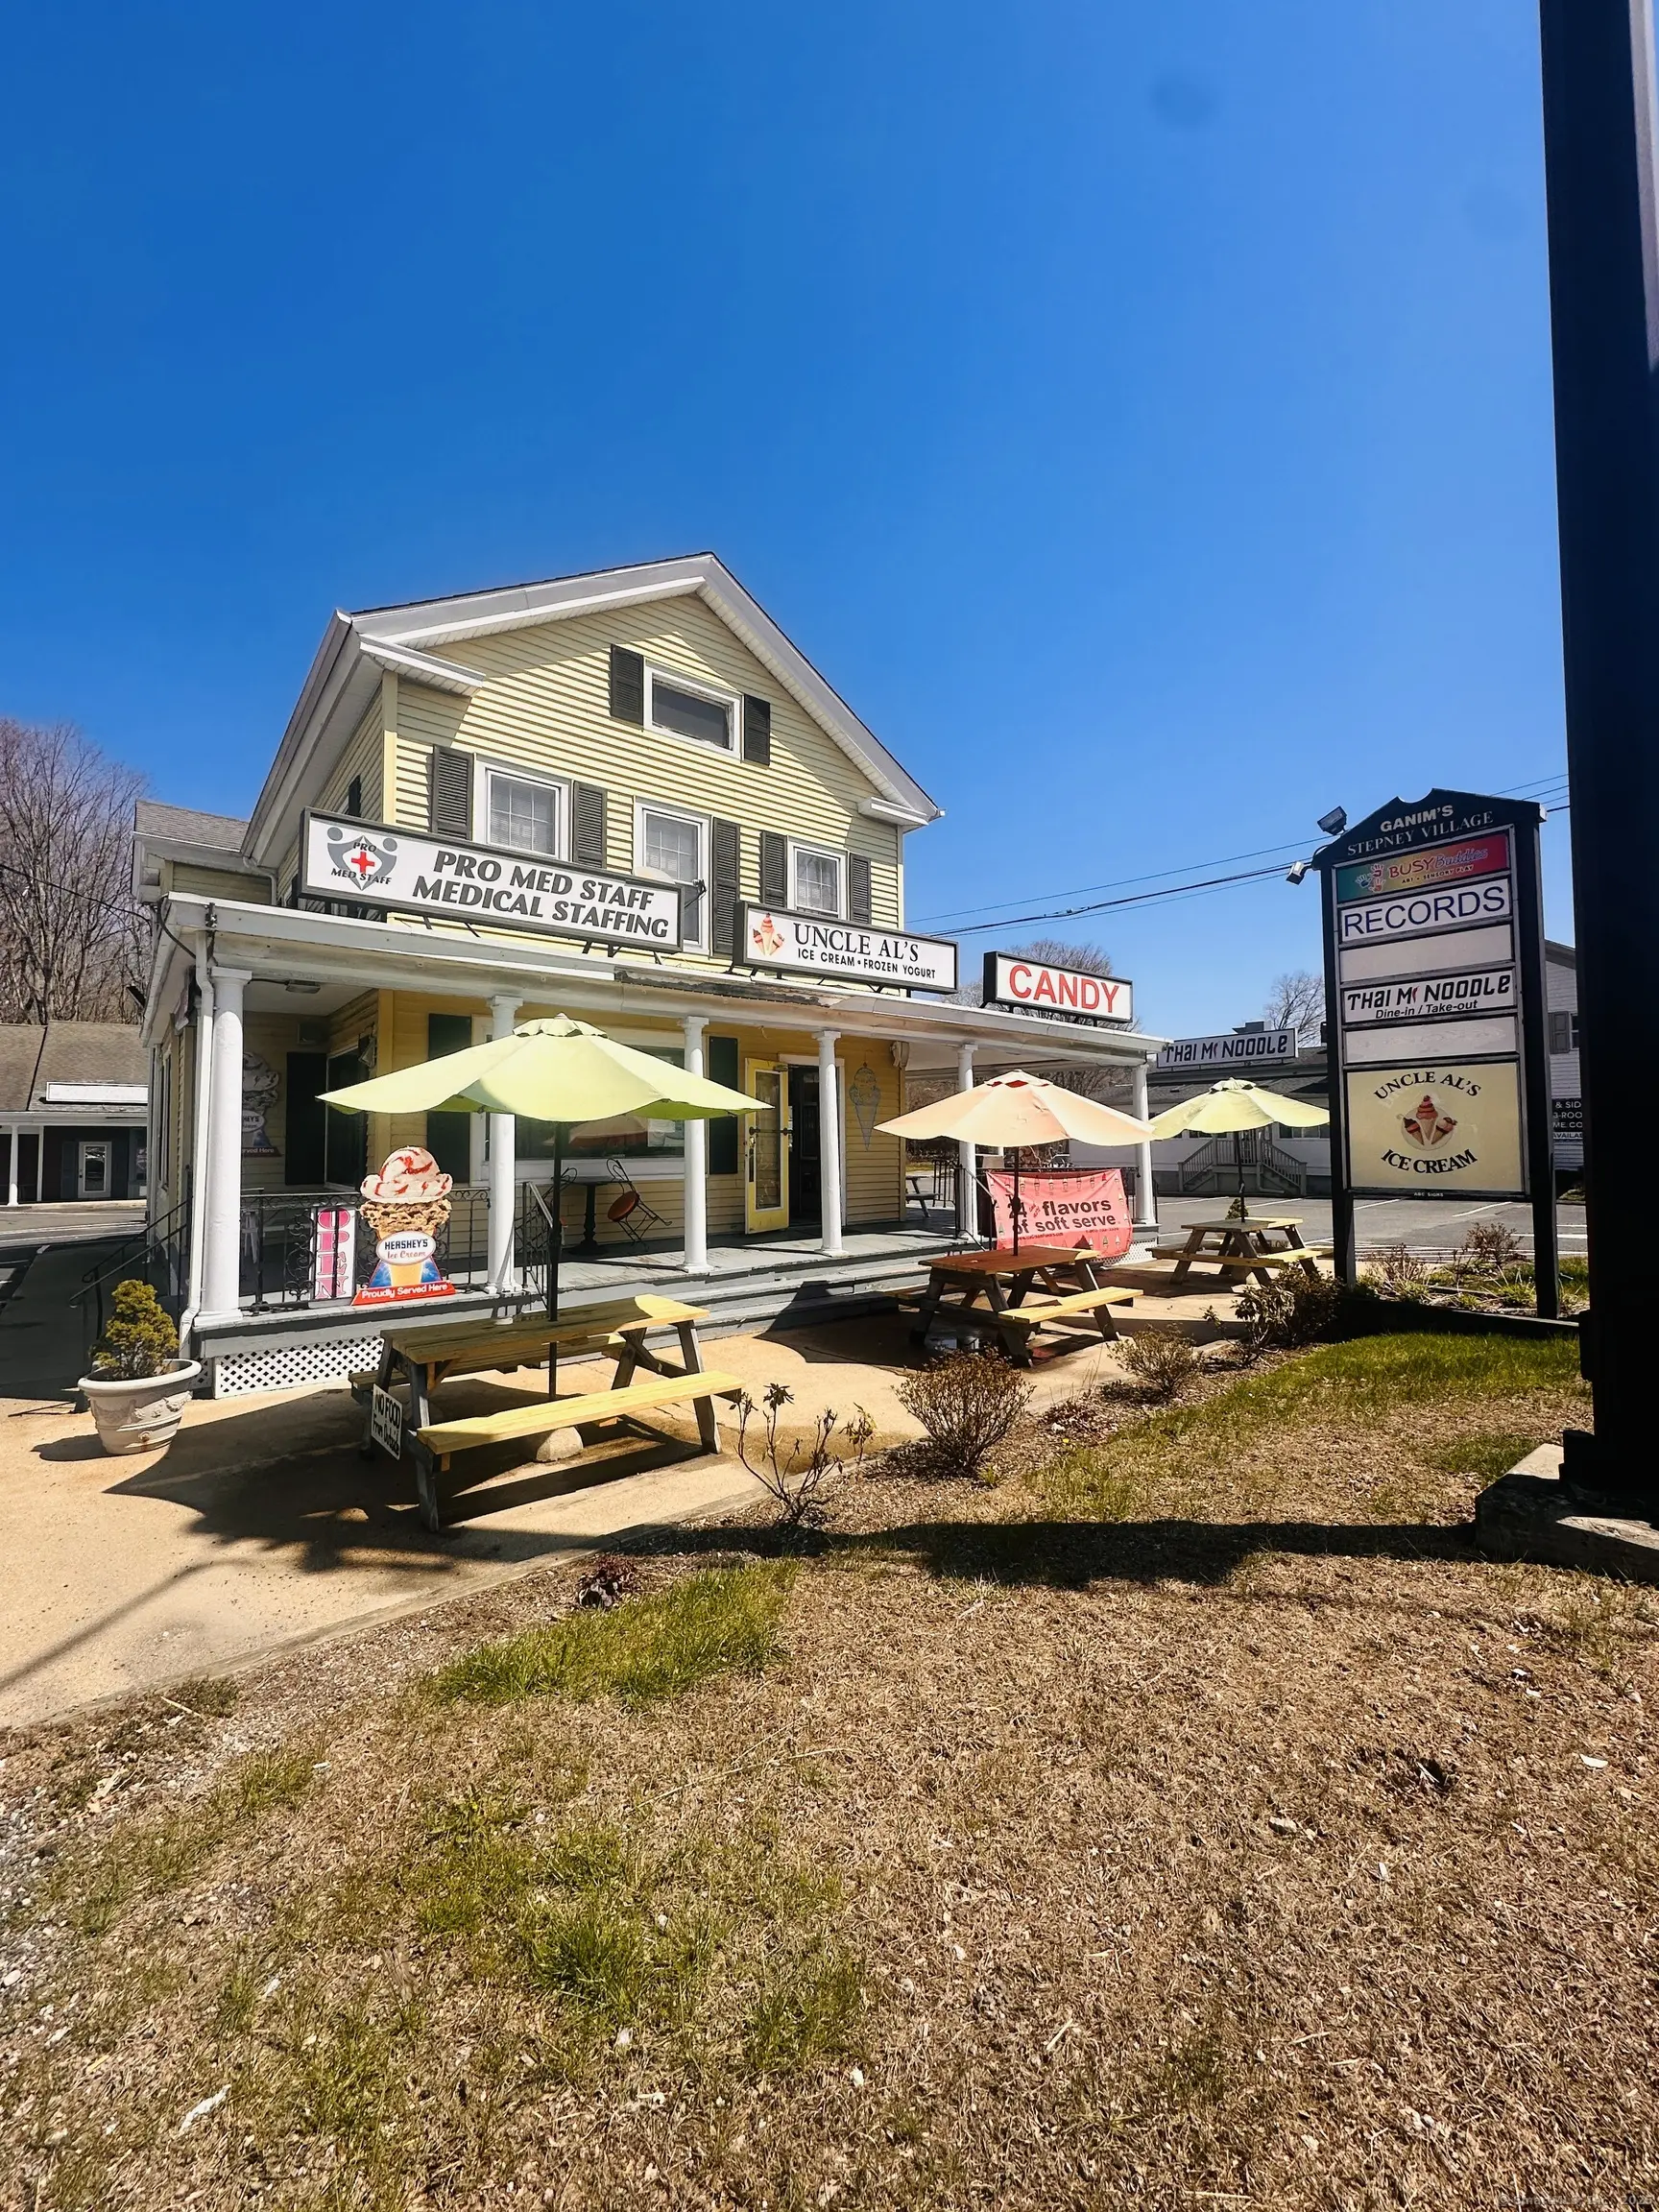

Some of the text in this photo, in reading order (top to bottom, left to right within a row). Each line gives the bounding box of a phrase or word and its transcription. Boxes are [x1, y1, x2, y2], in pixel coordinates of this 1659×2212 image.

[1381, 805, 1454, 832] GANIM'S
[1347, 810, 1495, 855] STEPNEY VILLAGE
[352, 841, 376, 854] PRO
[331, 868, 392, 885] MED STAFF
[1388, 848, 1488, 878] BUSY Buddies
[1456, 865, 1474, 874] PLAY
[433, 850, 655, 910] PRO MED STAFF
[413, 876, 668, 938] MEDICAL STAFFING
[1344, 886, 1505, 937] RECORDS
[793, 923, 919, 962] UNCLE AL'S
[798, 948, 936, 979] ICE CREAM FROZEN YOGURT
[1009, 965, 1119, 1013] CANDY
[1376, 1007, 1415, 1019] Dine-in
[1426, 999, 1478, 1014] Take-out
[1374, 1071, 1481, 1099] UNCLE AL'S
[1381, 1149, 1478, 1173] ICE CREAM
[1043, 1199, 1112, 1216] flavors
[1036, 1216, 1070, 1232] soft
[1072, 1214, 1116, 1228] serve
[316, 1208, 350, 1299] OPEN
[385, 1239, 428, 1250] HERSHEY'S
[400, 1250, 426, 1259] Cream
[362, 1284, 448, 1299] Proudly Served Here
[375, 1390, 400, 1429] NO FOOD
